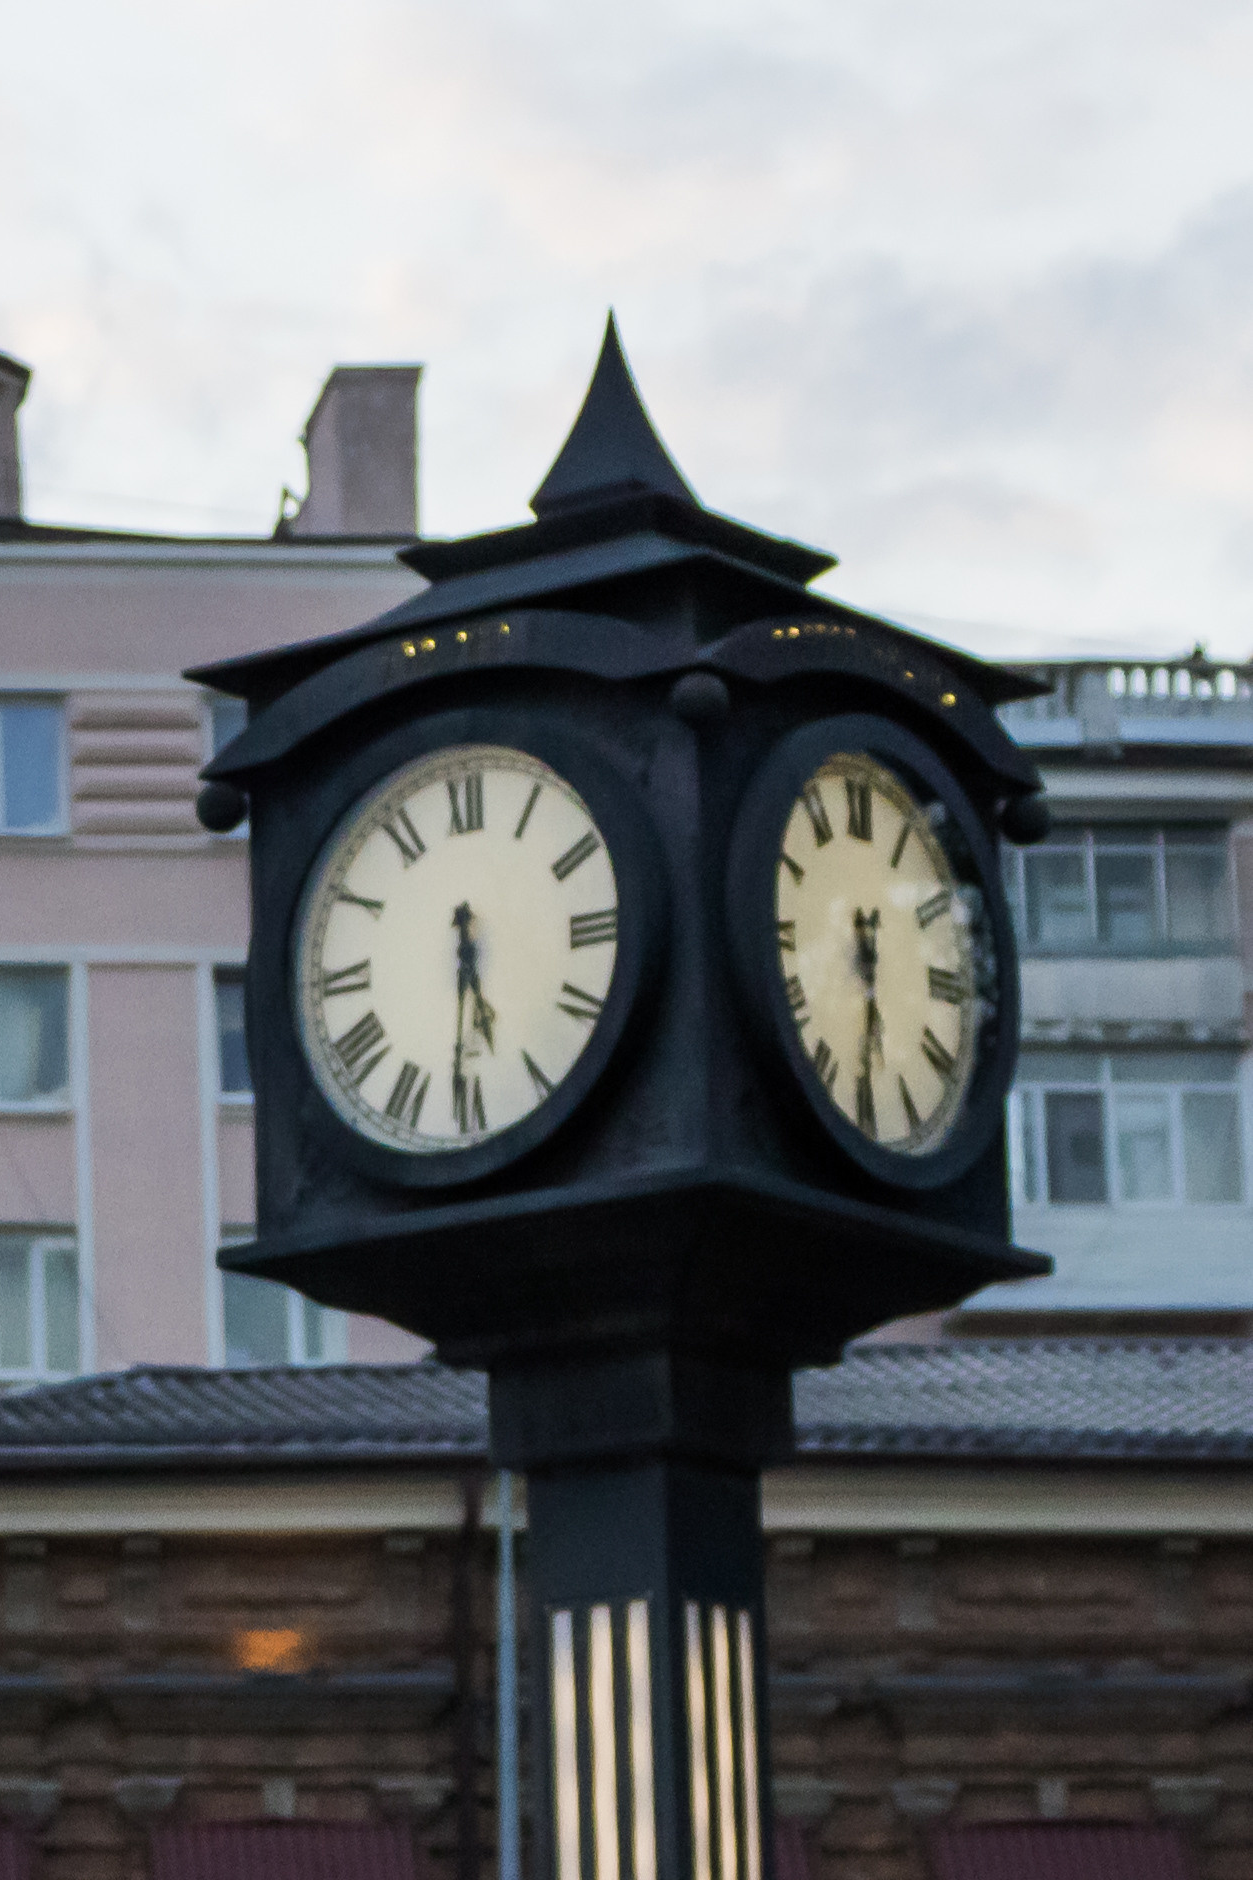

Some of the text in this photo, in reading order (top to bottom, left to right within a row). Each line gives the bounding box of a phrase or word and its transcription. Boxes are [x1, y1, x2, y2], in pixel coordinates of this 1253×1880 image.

[447, 774, 484, 836] XII
[514, 782, 542, 840] I
[380, 808, 428, 870] XI
[551, 829, 602, 882] II
[890, 820, 913, 869] I
[569, 908, 618, 950] III
[555, 982, 604, 1020] IV
[333, 1009, 393, 1089] VIII
[520, 1047, 556, 1101] V
[383, 1059, 433, 1131] VII
